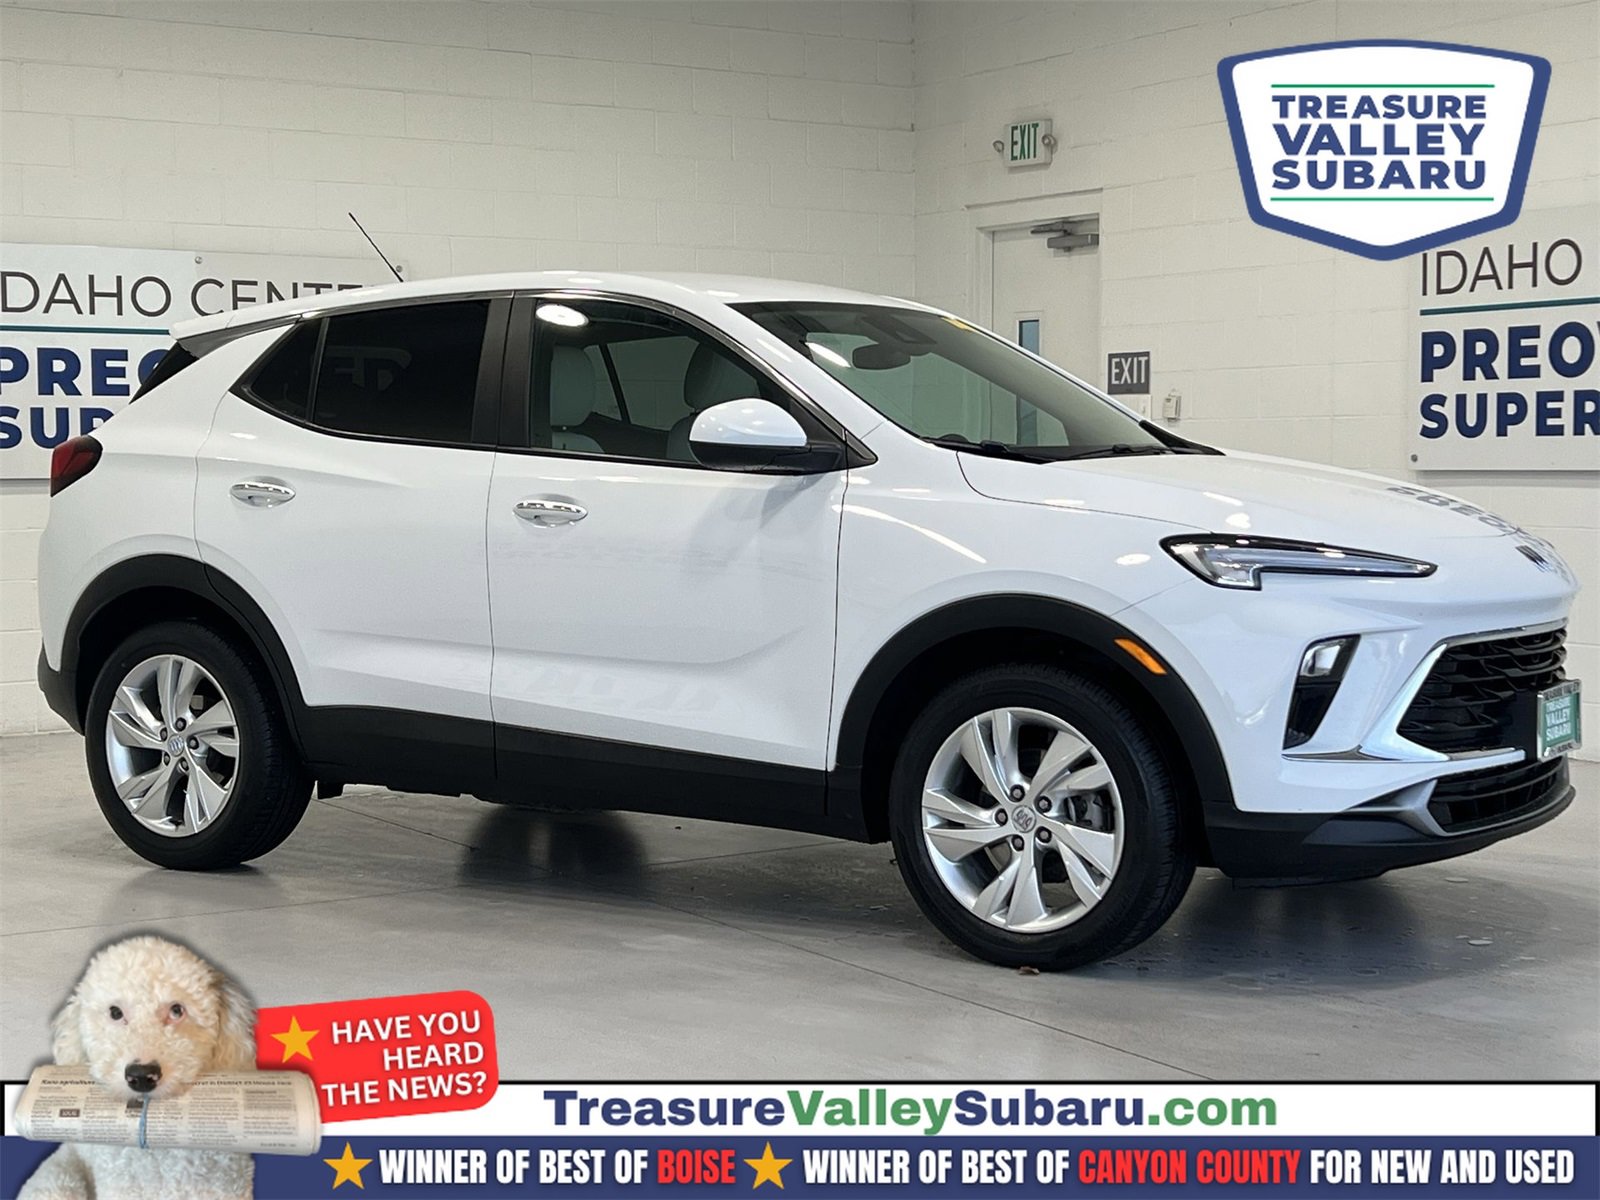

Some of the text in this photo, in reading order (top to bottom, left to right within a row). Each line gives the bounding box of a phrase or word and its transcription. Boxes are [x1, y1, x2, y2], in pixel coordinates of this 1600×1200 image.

[1010, 122, 1040, 161] EXIT
[1421, 238, 1583, 296] IDAHO
[0, 270, 171, 317] DAHO
[1111, 355, 1149, 386] EXIT
[1420, 321, 1600, 383] PREO
[1419, 389, 1600, 439] SUPER
